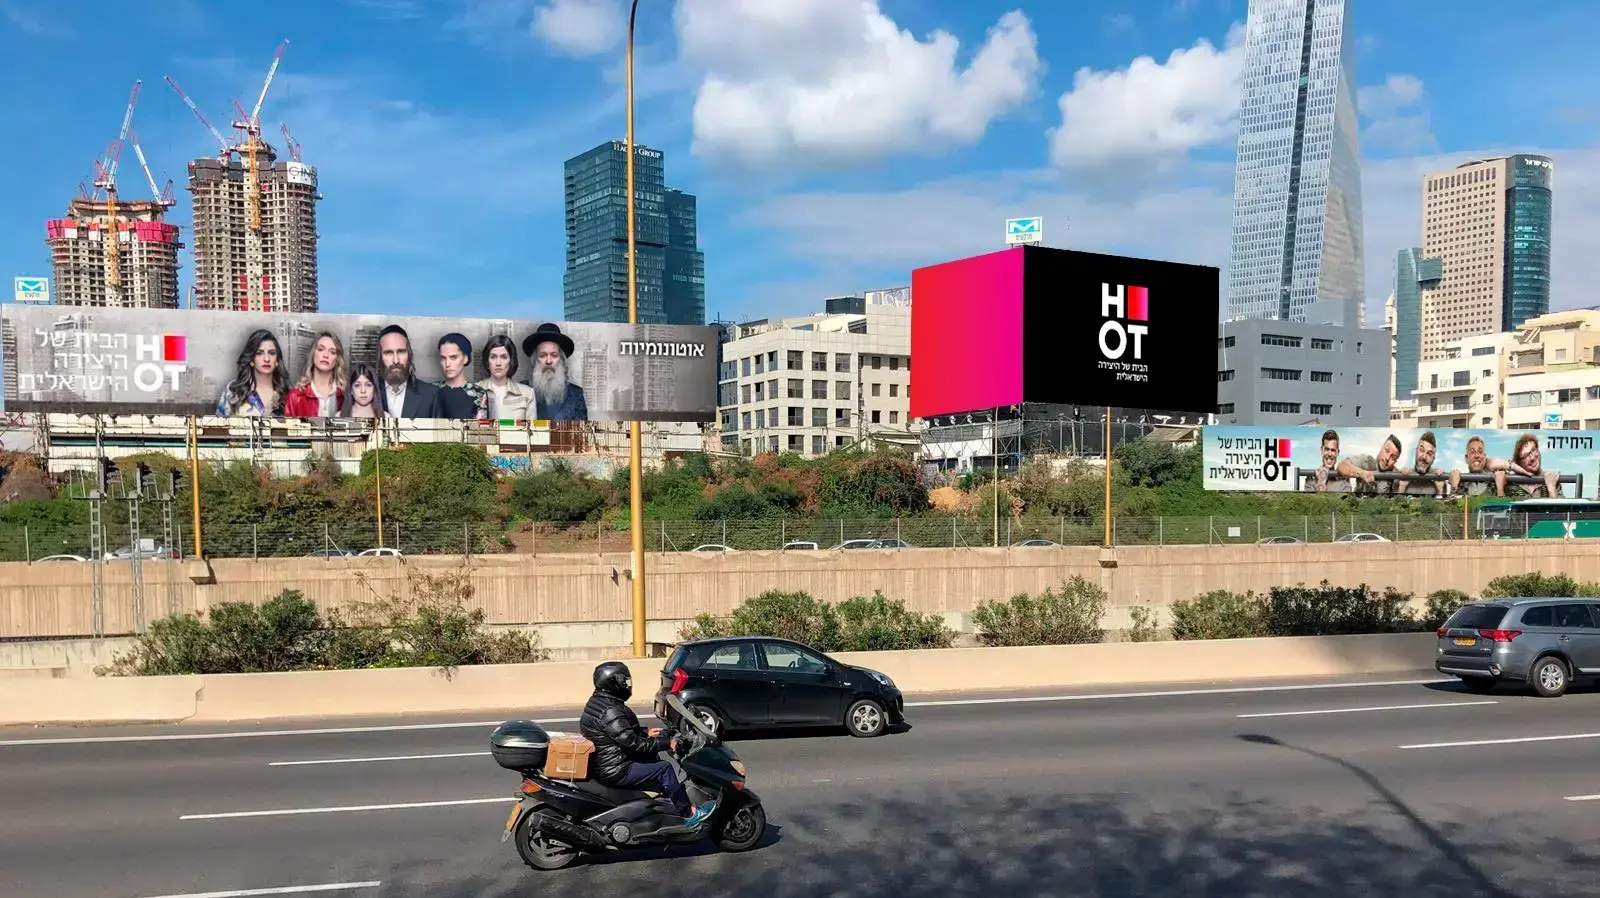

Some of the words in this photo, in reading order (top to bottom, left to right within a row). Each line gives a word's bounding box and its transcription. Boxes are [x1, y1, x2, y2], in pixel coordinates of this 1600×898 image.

[638, 148, 661, 158] GROUP
[35, 328, 66, 348] של
[74, 332, 128, 349] הבית
[620, 341, 705, 357] אוטונומיות
[54, 352, 128, 370] היצירה
[1097, 361, 1121, 370] היצירה
[1121, 361, 1131, 370] של
[1131, 363, 1149, 372] הבית
[18, 371, 128, 391] הישראלית
[1116, 371, 1149, 382] הישראלית
[1217, 436, 1233, 449] של
[1235, 438, 1262, 450] הבית
[1547, 436, 1593, 449] היחידה
[1225, 453, 1262, 465] היצירה
[1209, 465, 1262, 480] הישראלית
